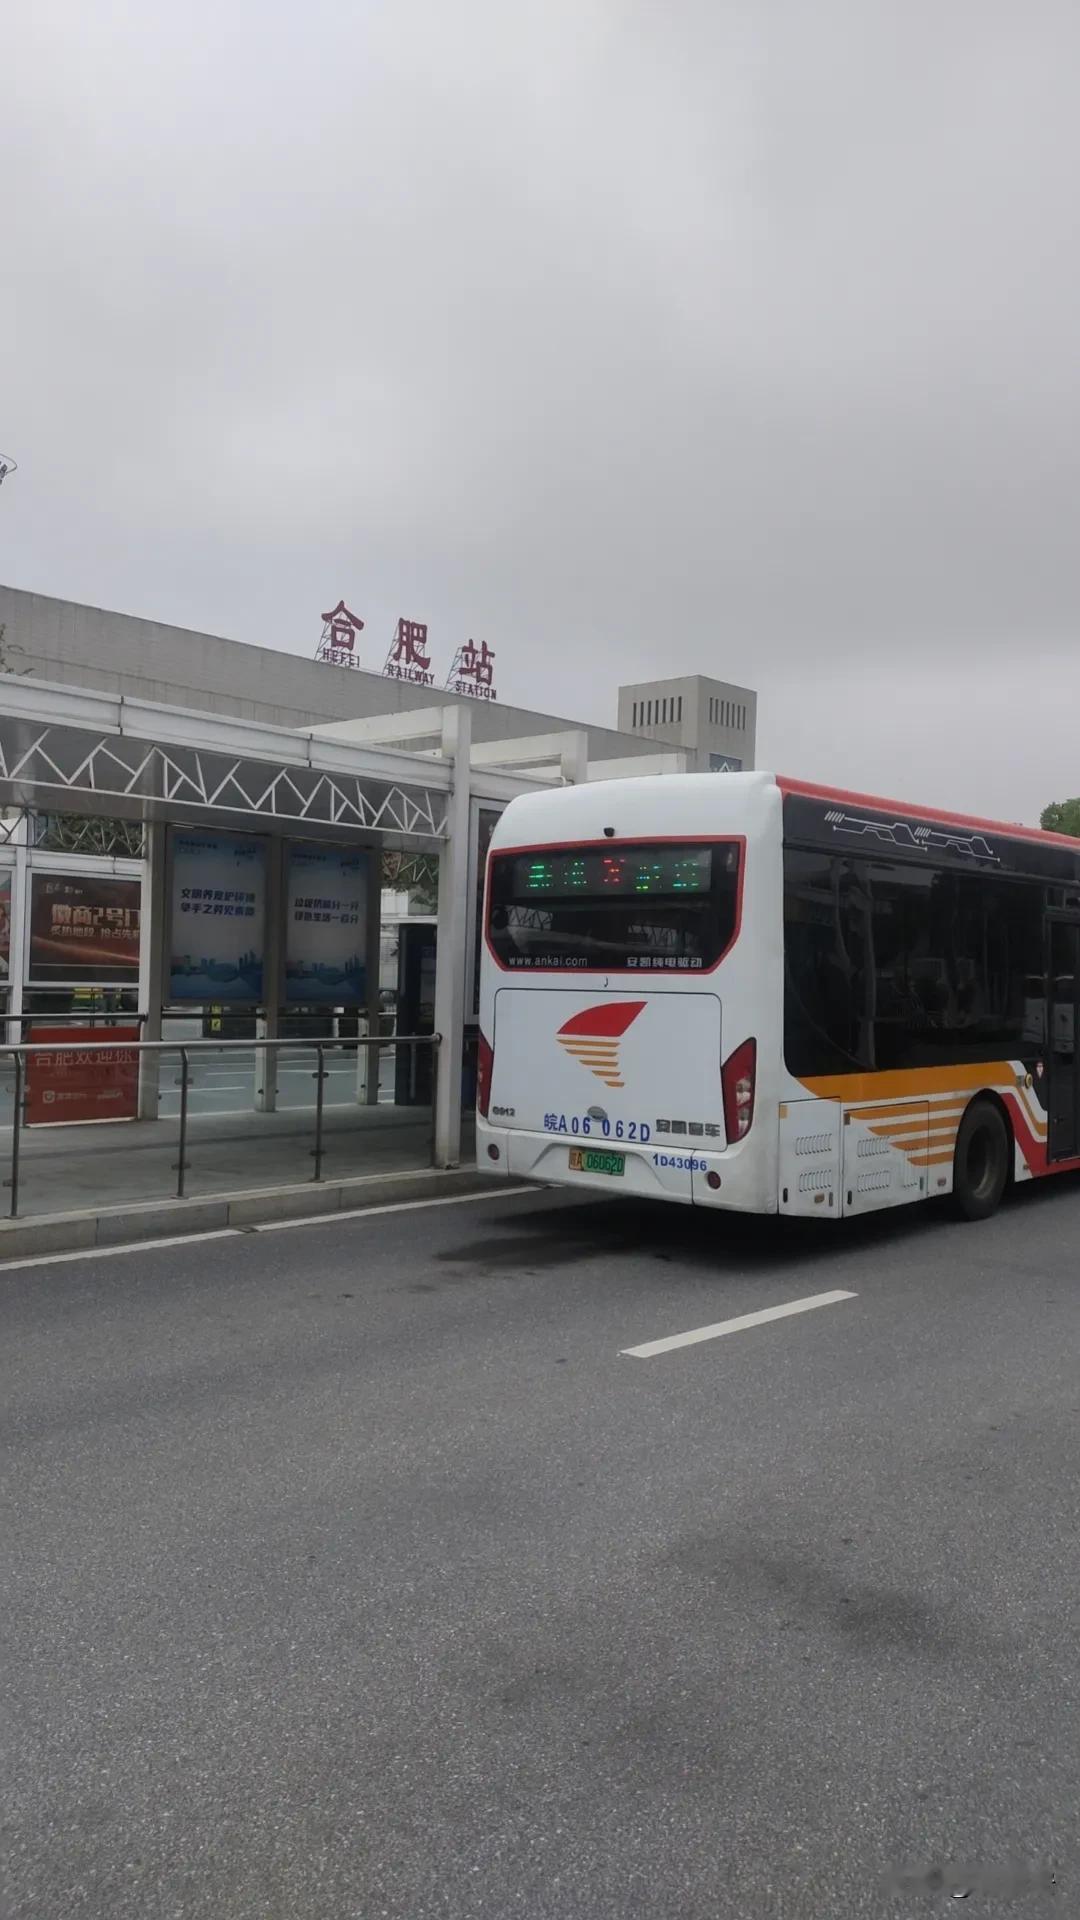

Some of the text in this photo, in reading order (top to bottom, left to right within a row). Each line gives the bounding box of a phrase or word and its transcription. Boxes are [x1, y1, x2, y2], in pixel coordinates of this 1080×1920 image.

[321, 600, 495, 685] 合肥站
[323, 648, 496, 700] HEFEI RAILWAY STATION
[509, 956, 587, 967] www.ankai.com
[653, 1153, 707, 1171] 1D43096
